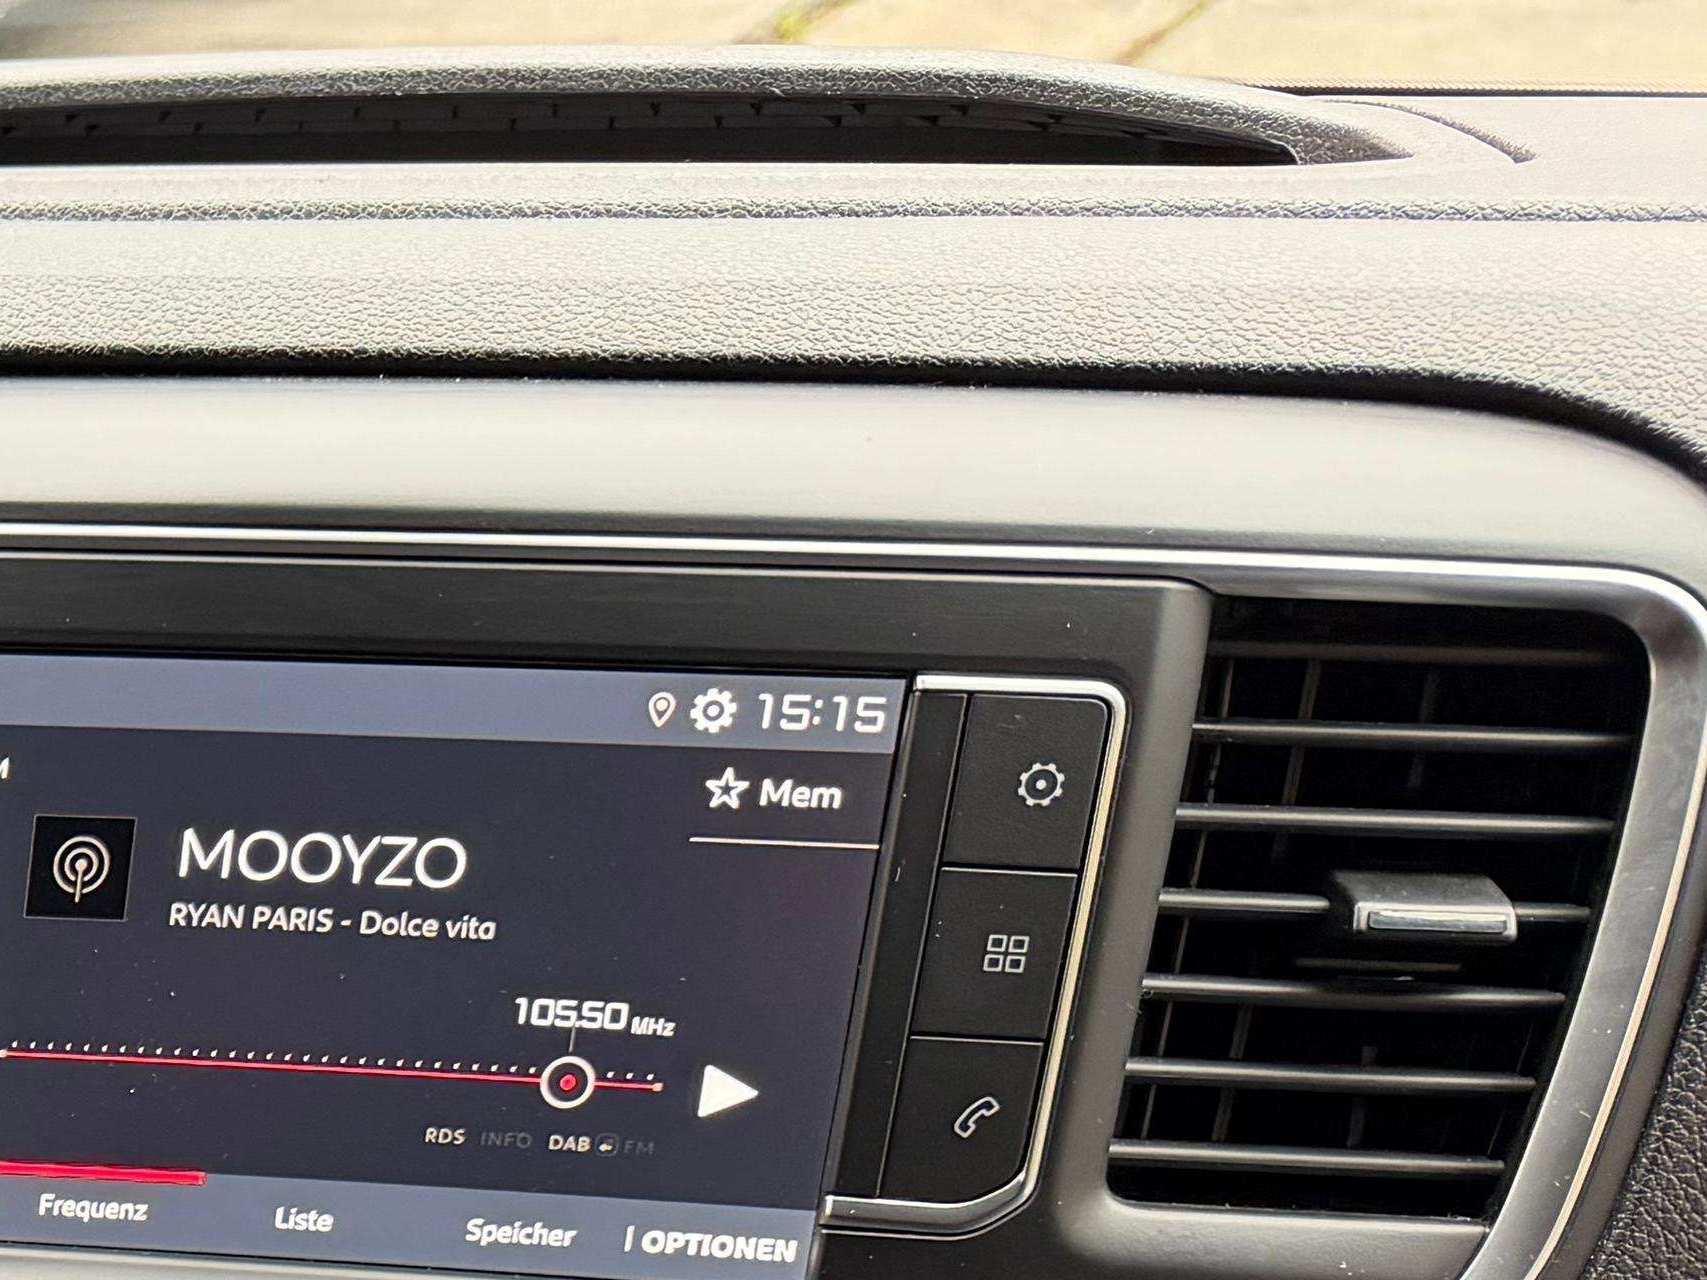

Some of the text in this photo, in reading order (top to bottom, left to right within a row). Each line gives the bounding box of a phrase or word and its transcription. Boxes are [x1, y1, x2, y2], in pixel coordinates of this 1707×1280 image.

[758, 692, 887, 733] 15:15
[758, 778, 843, 810] Mem
[178, 827, 468, 889] MOOYZO
[168, 901, 246, 929] RYAN
[251, 904, 334, 933] PARIS
[358, 909, 439, 939] Dolce
[444, 914, 497, 941] vita
[630, 1015, 677, 1037] MHz
[424, 1127, 467, 1146] RDS
[480, 1131, 532, 1150] INFO
[548, 1135, 591, 1153] DAB
[38, 1193, 149, 1223] Frequenz
[274, 1206, 334, 1233] Liste
[465, 1218, 579, 1247] Speicher
[641, 1229, 798, 1263] OPTIONEN
